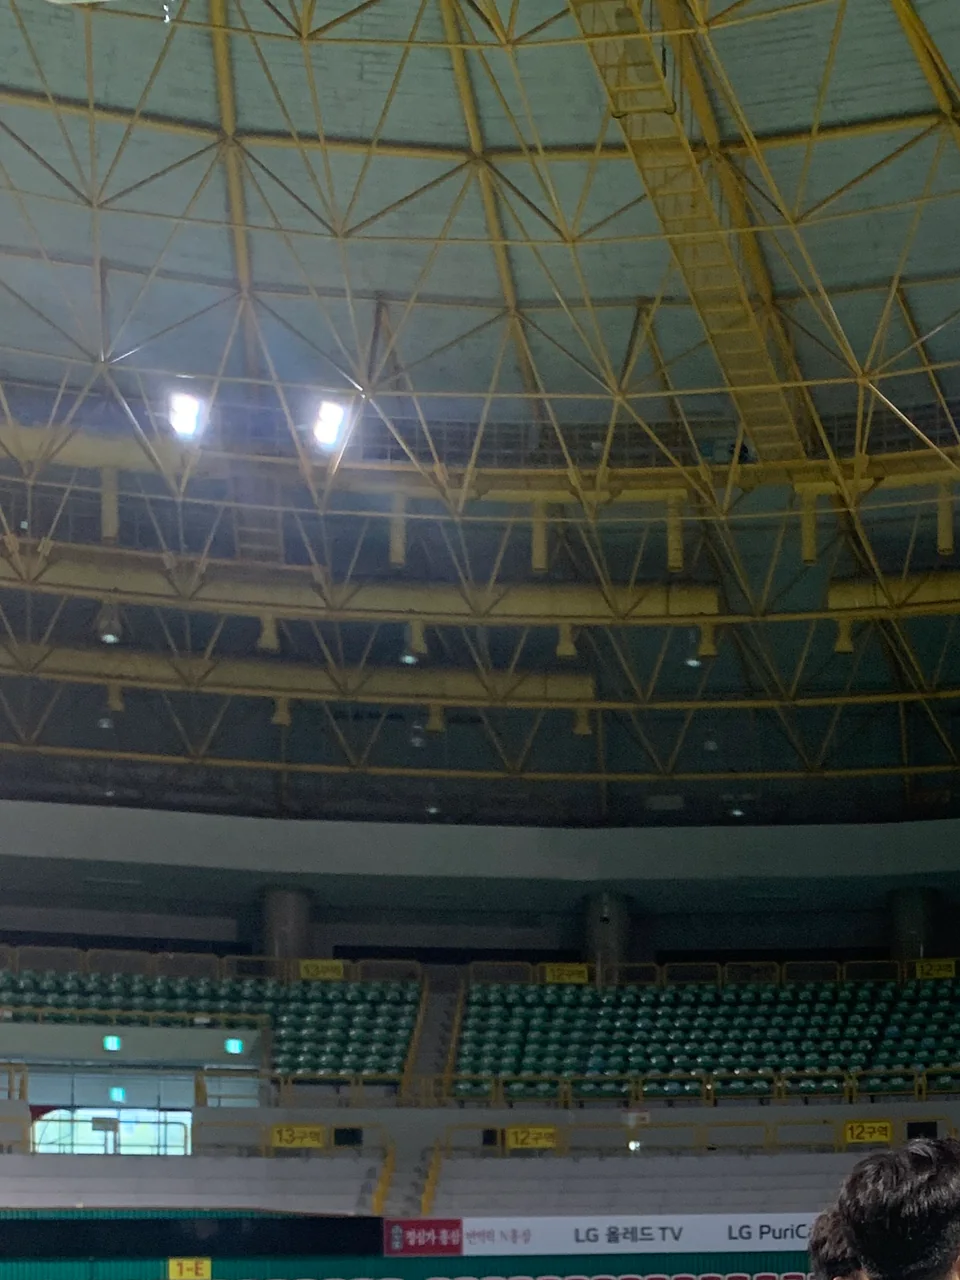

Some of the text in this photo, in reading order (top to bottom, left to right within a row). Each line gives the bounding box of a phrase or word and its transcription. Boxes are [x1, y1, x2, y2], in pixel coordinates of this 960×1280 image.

[276, 1127, 321, 1144] 13구역
[511, 1130, 555, 1146] 12구역
[848, 1124, 888, 1141] 12구역
[574, 1225, 683, 1244] LG 올레드 TV
[727, 1224, 752, 1241] LG
[176, 1260, 205, 1277] 1-E
